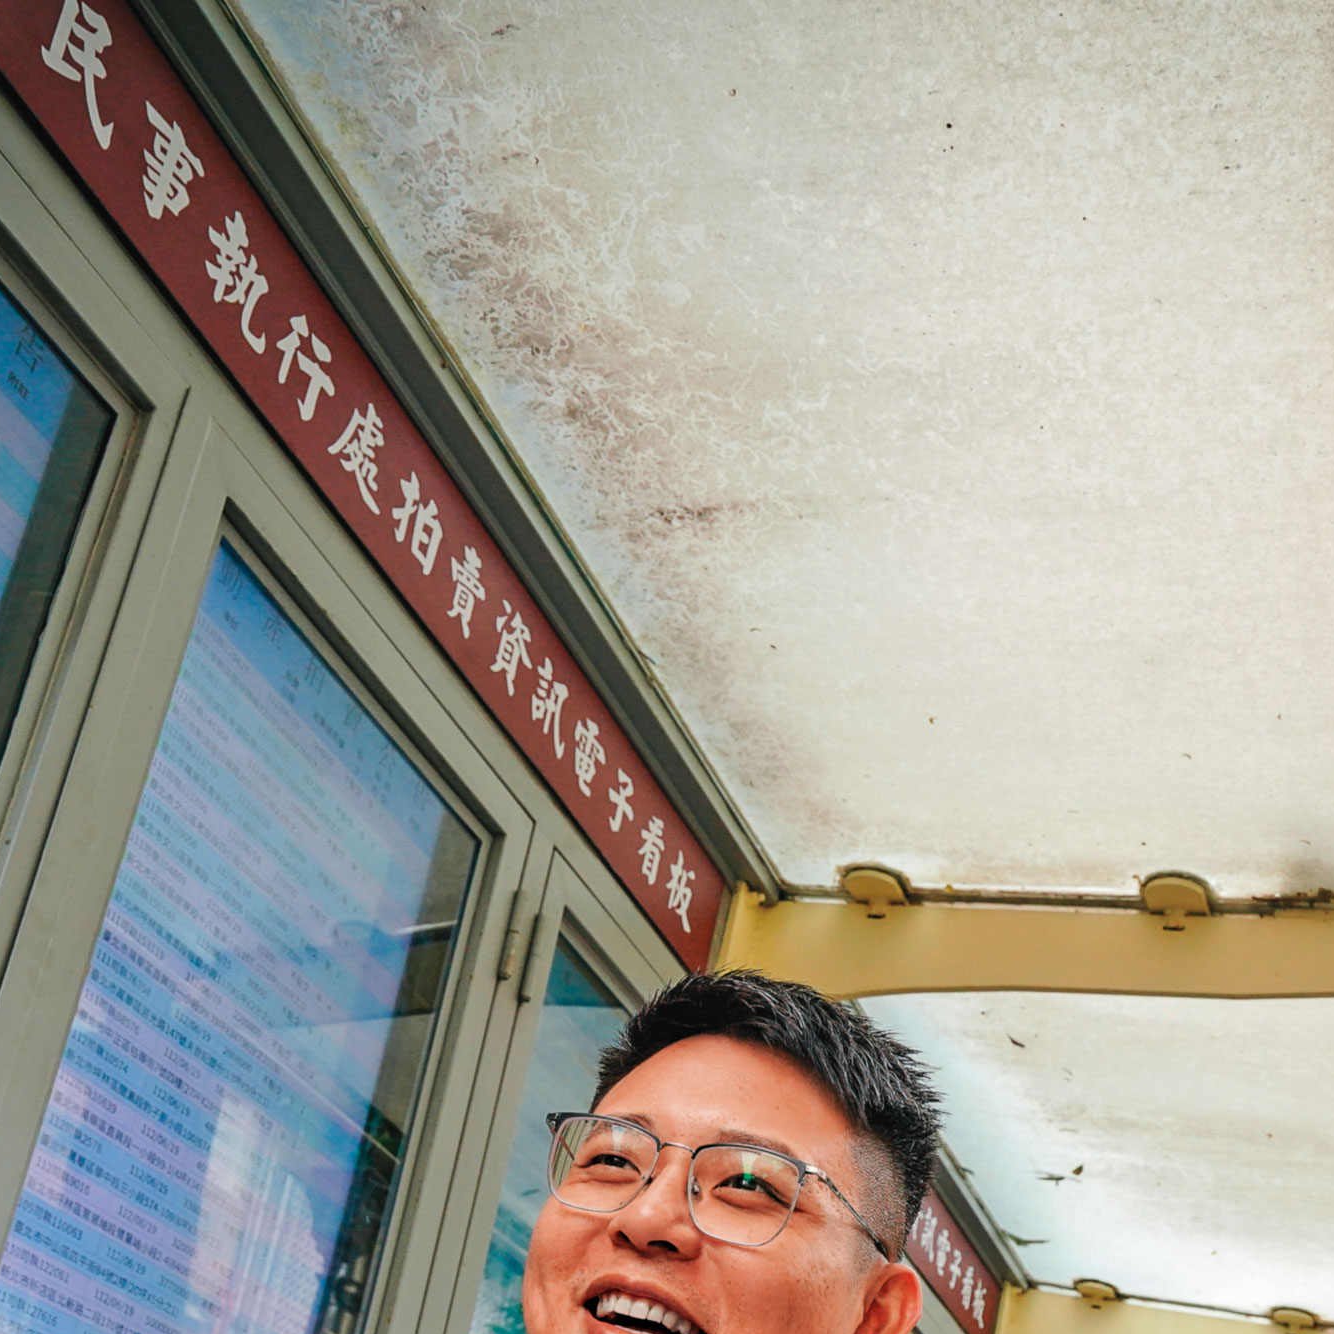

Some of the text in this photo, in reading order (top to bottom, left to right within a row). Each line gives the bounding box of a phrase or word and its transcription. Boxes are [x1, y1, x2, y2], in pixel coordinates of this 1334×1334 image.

[40, 0, 693, 933] 民事執行處拍賣資訊電子看板
